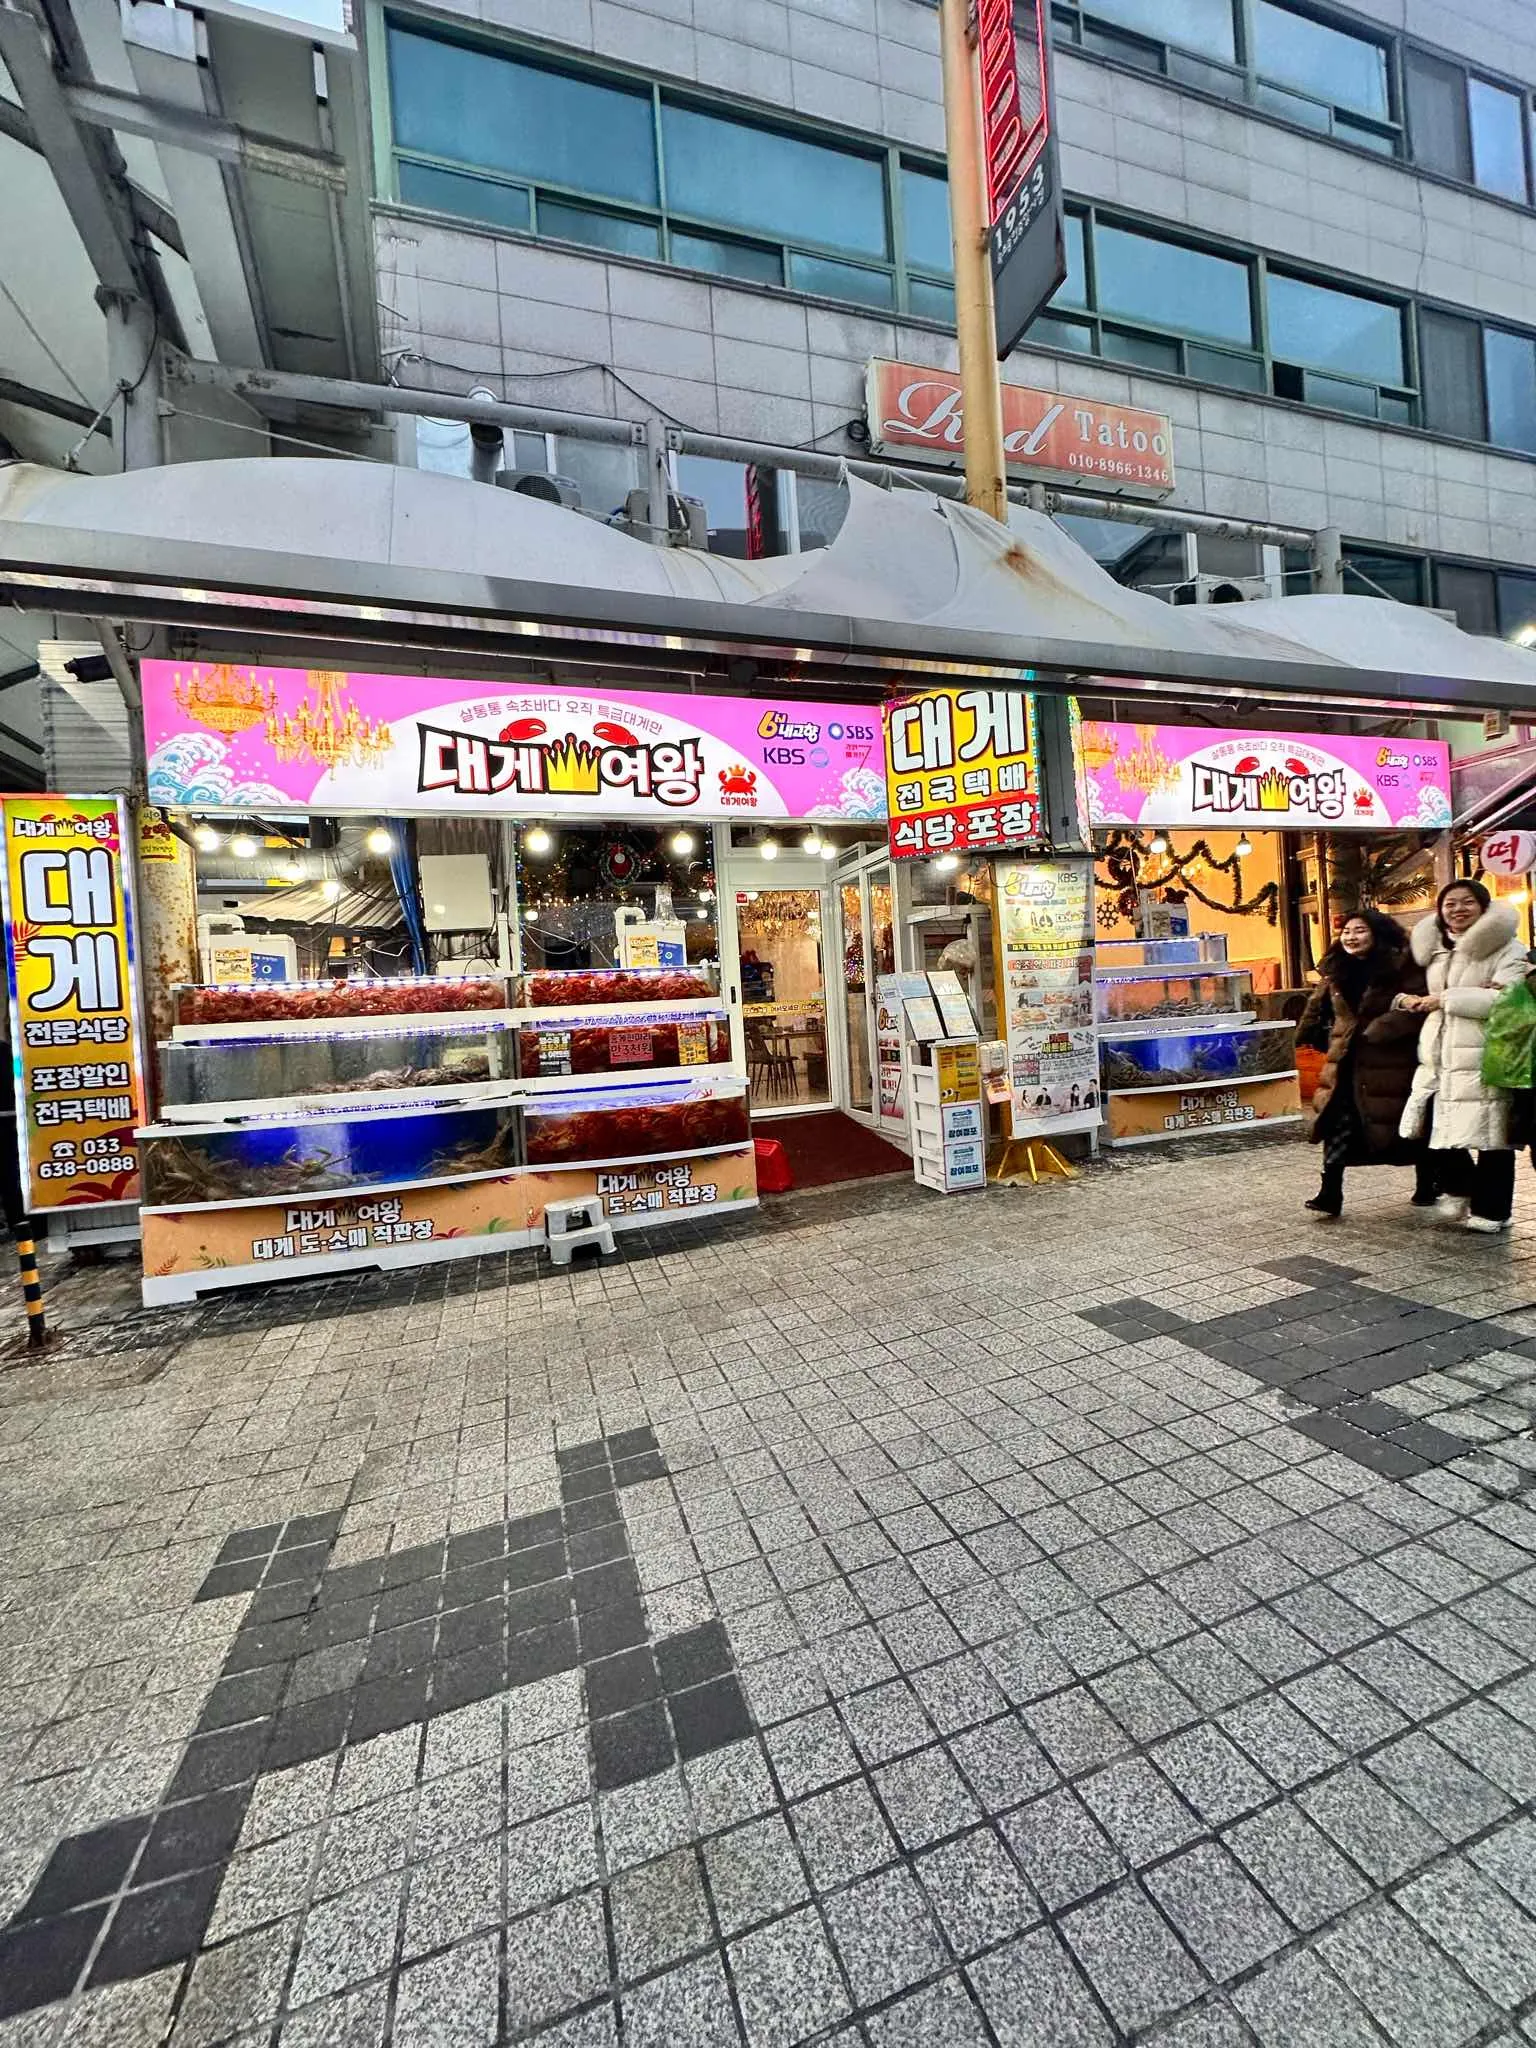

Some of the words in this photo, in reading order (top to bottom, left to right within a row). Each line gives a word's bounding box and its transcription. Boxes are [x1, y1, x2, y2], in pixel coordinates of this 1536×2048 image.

[994, 164, 1044, 250] 1953
[883, 381, 1065, 457] Rd
[1074, 410, 1168, 456] Tatoo
[506, 699, 561, 713] 속초바다
[566, 701, 593, 717] 오직
[598, 704, 663, 736] 특급대게만
[846, 725, 874, 740] SBS
[889, 690, 1028, 775] 대게
[416, 722, 548, 795] 대게
[600, 737, 705, 807] 여왕
[763, 747, 806, 765] KBS
[1422, 756, 1438, 767] SBS
[1191, 762, 1261, 813] 대게
[1288, 768, 1347, 820] 여왕
[1376, 774, 1400, 787] KBS
[720, 796, 758, 808] 대게여왕
[13, 817, 56, 838] 대게
[74, 818, 113, 839] 여왕
[1487, 835, 1520, 872] 떡
[1057, 872, 1078, 883] KBS
[20, 847, 124, 1013] 대게
[25, 1018, 129, 1047] 전문식당
[32, 1063, 131, 1092] 포장할인
[34, 1096, 134, 1126] 전국택배
[1215, 1090, 1239, 1108] 여왕
[82, 1137, 121, 1156] 033
[38, 1156, 135, 1180] 638-0888
[596, 1173, 637, 1195] 대게
[655, 1164, 692, 1188] 여왕
[668, 1184, 718, 1206] 직판장
[286, 1209, 336, 1233] 대게
[357, 1198, 403, 1224] 여왕
[372, 1220, 434, 1244] 직판장
